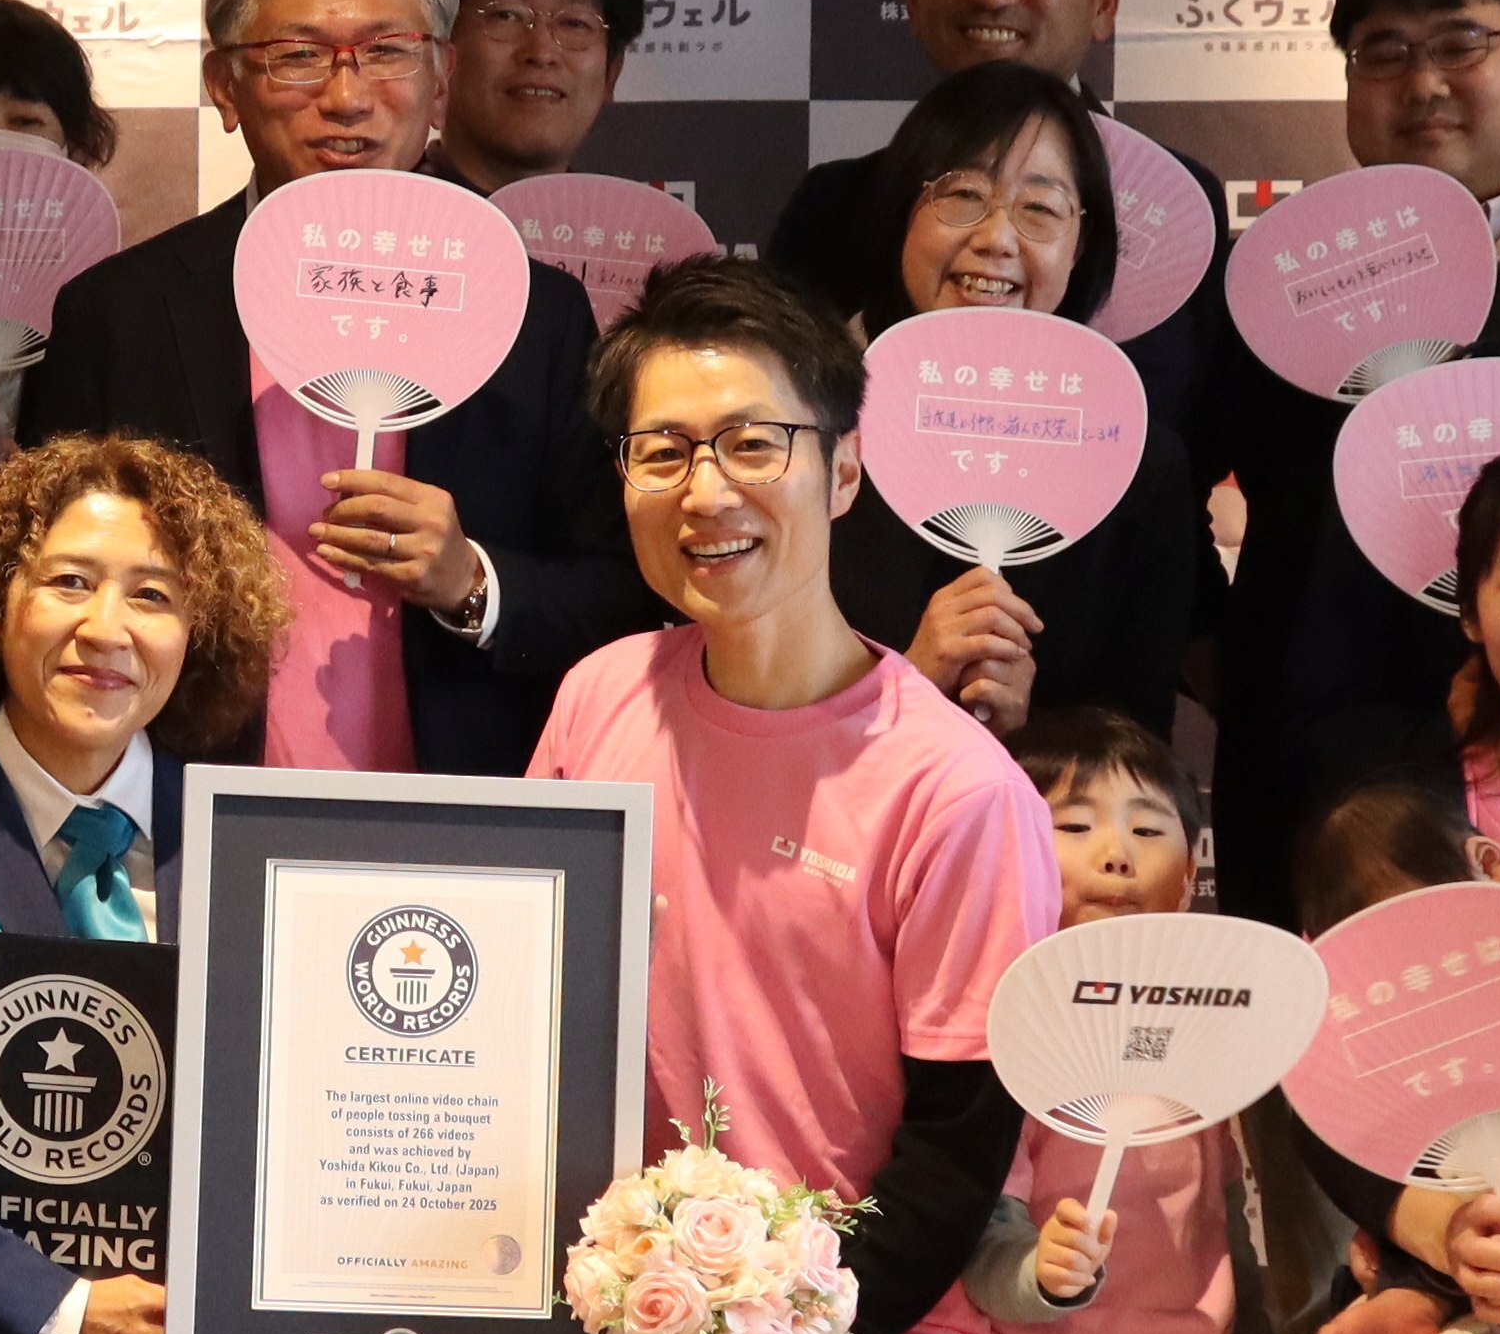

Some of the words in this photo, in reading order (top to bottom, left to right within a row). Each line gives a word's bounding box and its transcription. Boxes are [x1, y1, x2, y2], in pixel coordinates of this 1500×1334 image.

[302, 223, 467, 261] 私の幸せは
[521, 218, 666, 254] 私の幸せは
[1273, 205, 1421, 274] 私の幸せは
[308, 265, 440, 308] 家族と食事
[331, 313, 410, 344] です。
[1333, 299, 1408, 332] です。
[917, 359, 1084, 395] 私の幸せは
[951, 449, 1029, 478] です。
[799, 846, 857, 883] YOSHIDA
[366, 913, 462, 950] GUINNESS
[354, 960, 397, 1025] WORLD
[402, 963, 471, 1031] RECORDS
[1129, 985, 1252, 1008] YOSHIDA
[344, 1045, 476, 1065] CERTIFICATE
[325, 1089, 347, 1102] The
[350, 1091, 390, 1105] largest
[394, 1092, 429, 1105] online
[432, 1094, 463, 1106] video
[467, 1095, 499, 1107] chain
[45, 1072, 152, 1171] RECORDS
[330, 1108, 343, 1120] of
[346, 1109, 384, 1123] people
[388, 1111, 430, 1124] tossing
[434, 1115, 441, 1123] a
[444, 1112, 491, 1126] bouquet
[346, 1127, 394, 1138] consists
[397, 1128, 410, 1139] of
[412, 1128, 434, 1139] 266
[437, 1129, 475, 1141] videos
[349, 1143, 370, 1154] and
[373, 1147, 398, 1156] was
[402, 1145, 454, 1157] achieved
[457, 1147, 472, 1160] by
[319, 1159, 365, 1172] Yoshida
[369, 1161, 401, 1173] Kikou
[456, 1164, 499, 1178] (Japan)
[346, 1178, 356, 1189] in
[436, 1181, 472, 1195] Japan
[320, 1196, 333, 1205] as
[337, 1195, 380, 1207] verified
[384, 1198, 398, 1208] on
[402, 1197, 415, 1208] 24
[419, 1197, 465, 1210] October
[469, 1199, 497, 1211] 2025
[3, 1228, 158, 1271] AZING
[336, 1256, 407, 1268] OFFICIALLY
[411, 1259, 469, 1270] AMAZING
